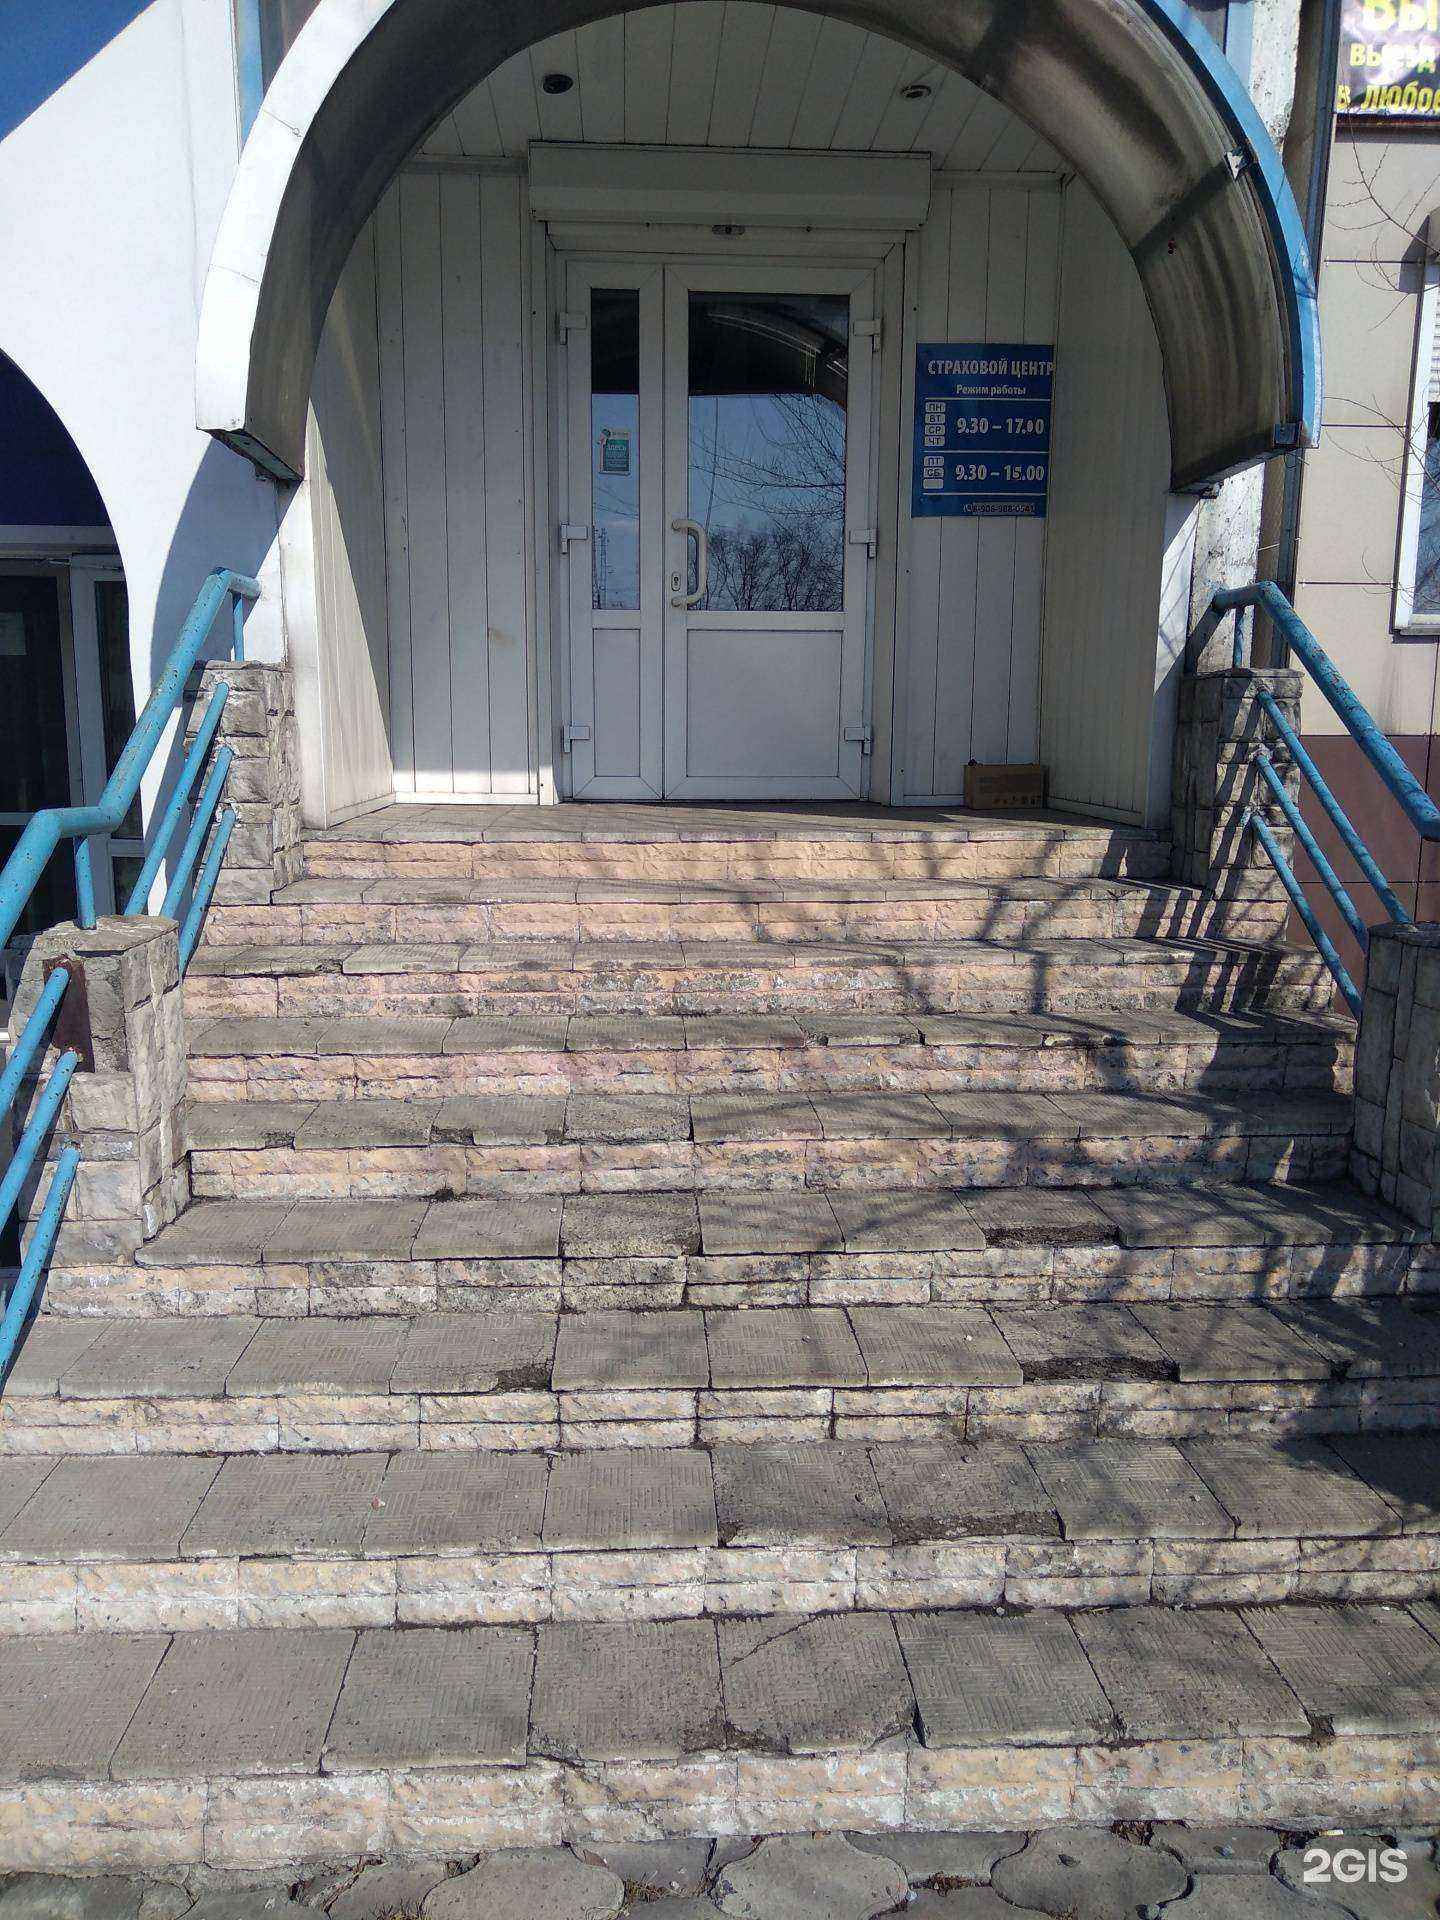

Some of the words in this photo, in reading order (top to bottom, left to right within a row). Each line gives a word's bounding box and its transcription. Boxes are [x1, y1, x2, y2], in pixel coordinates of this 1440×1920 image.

[927, 357, 1008, 375] СТРАХОВОЙ
[1011, 361, 1055, 378] ЦЕНТР
[956, 384, 988, 395] Режим
[990, 385, 1026, 396] работы
[928, 403, 942, 412] ПН
[928, 414, 942, 423] ВТ
[928, 426, 942, 434] СР
[956, 417, 989, 434] 9.30
[1006, 418, 1045, 434] 17.00
[928, 437, 941, 445] ЧТ
[927, 457, 941, 466] ПТ
[927, 468, 941, 477] СБ
[955, 464, 987, 481] 9.30
